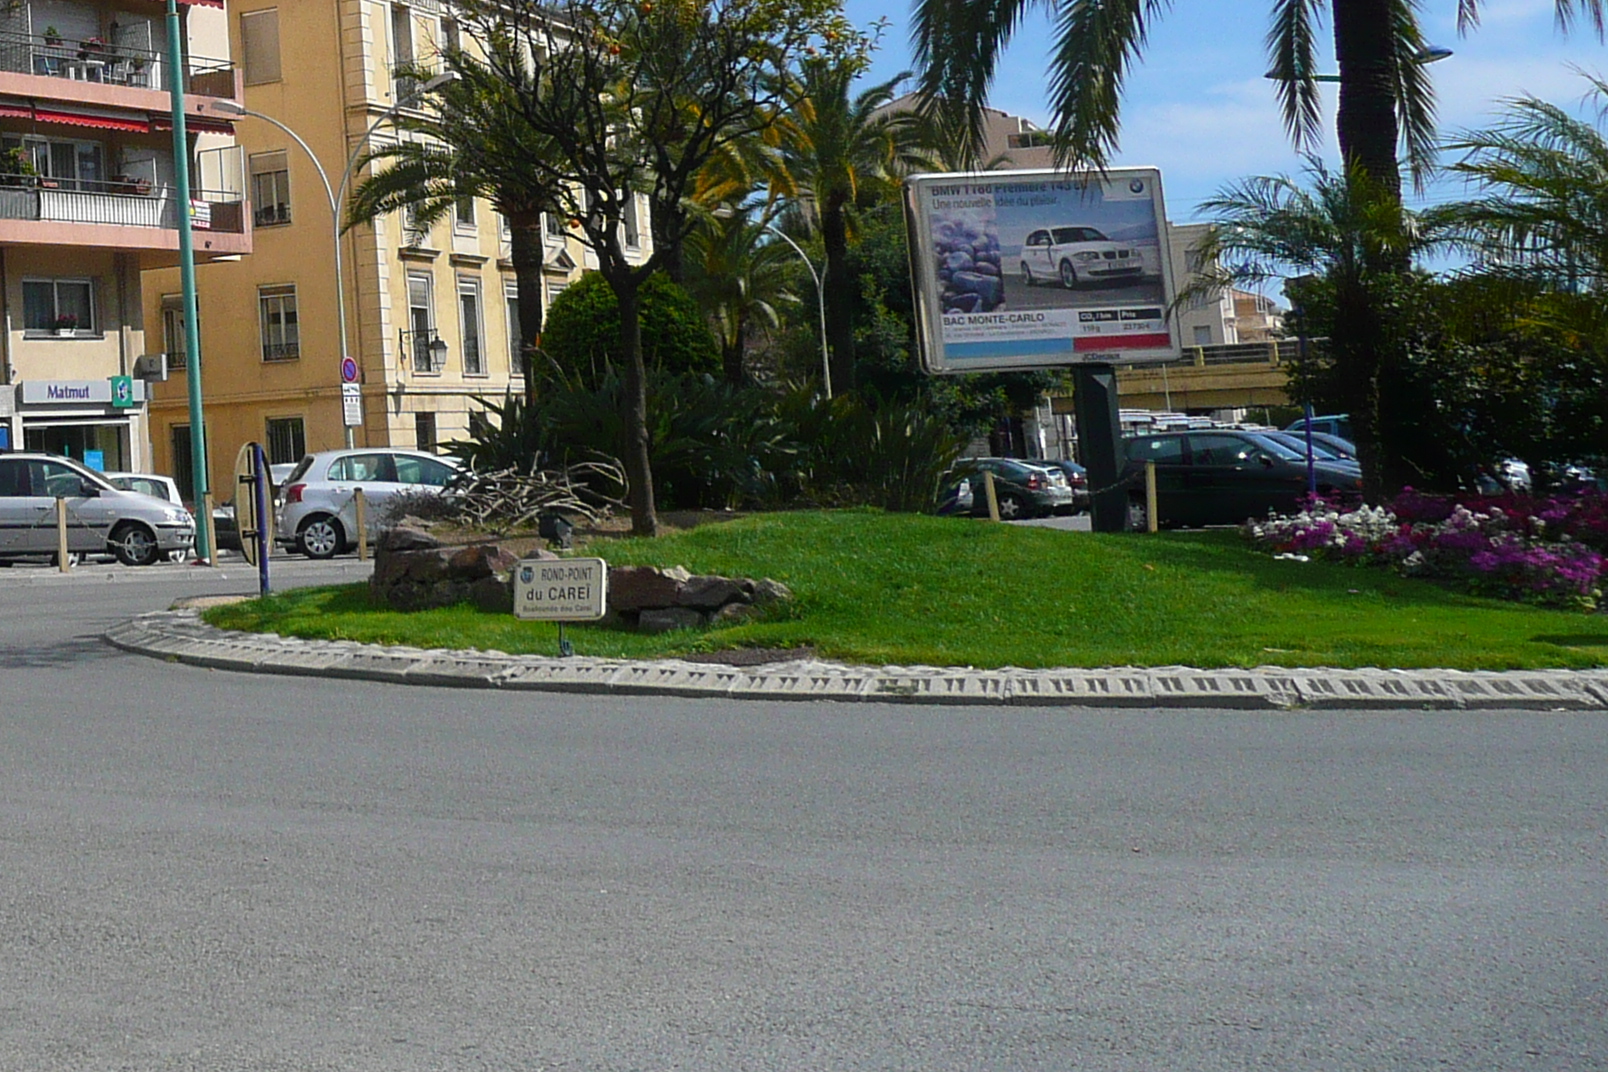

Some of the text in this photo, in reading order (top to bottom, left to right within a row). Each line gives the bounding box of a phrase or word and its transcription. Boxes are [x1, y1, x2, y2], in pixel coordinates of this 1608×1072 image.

[932, 186, 960, 196] BMW
[932, 198, 950, 209] Une
[953, 196, 992, 208] nouvelle
[1016, 195, 1029, 206] du
[943, 313, 1045, 325] BAC MONTE-CARLO
[47, 385, 89, 399] Matmut
[541, 567, 593, 581] ROND-POINT
[526, 583, 591, 601] du CAREÏ
